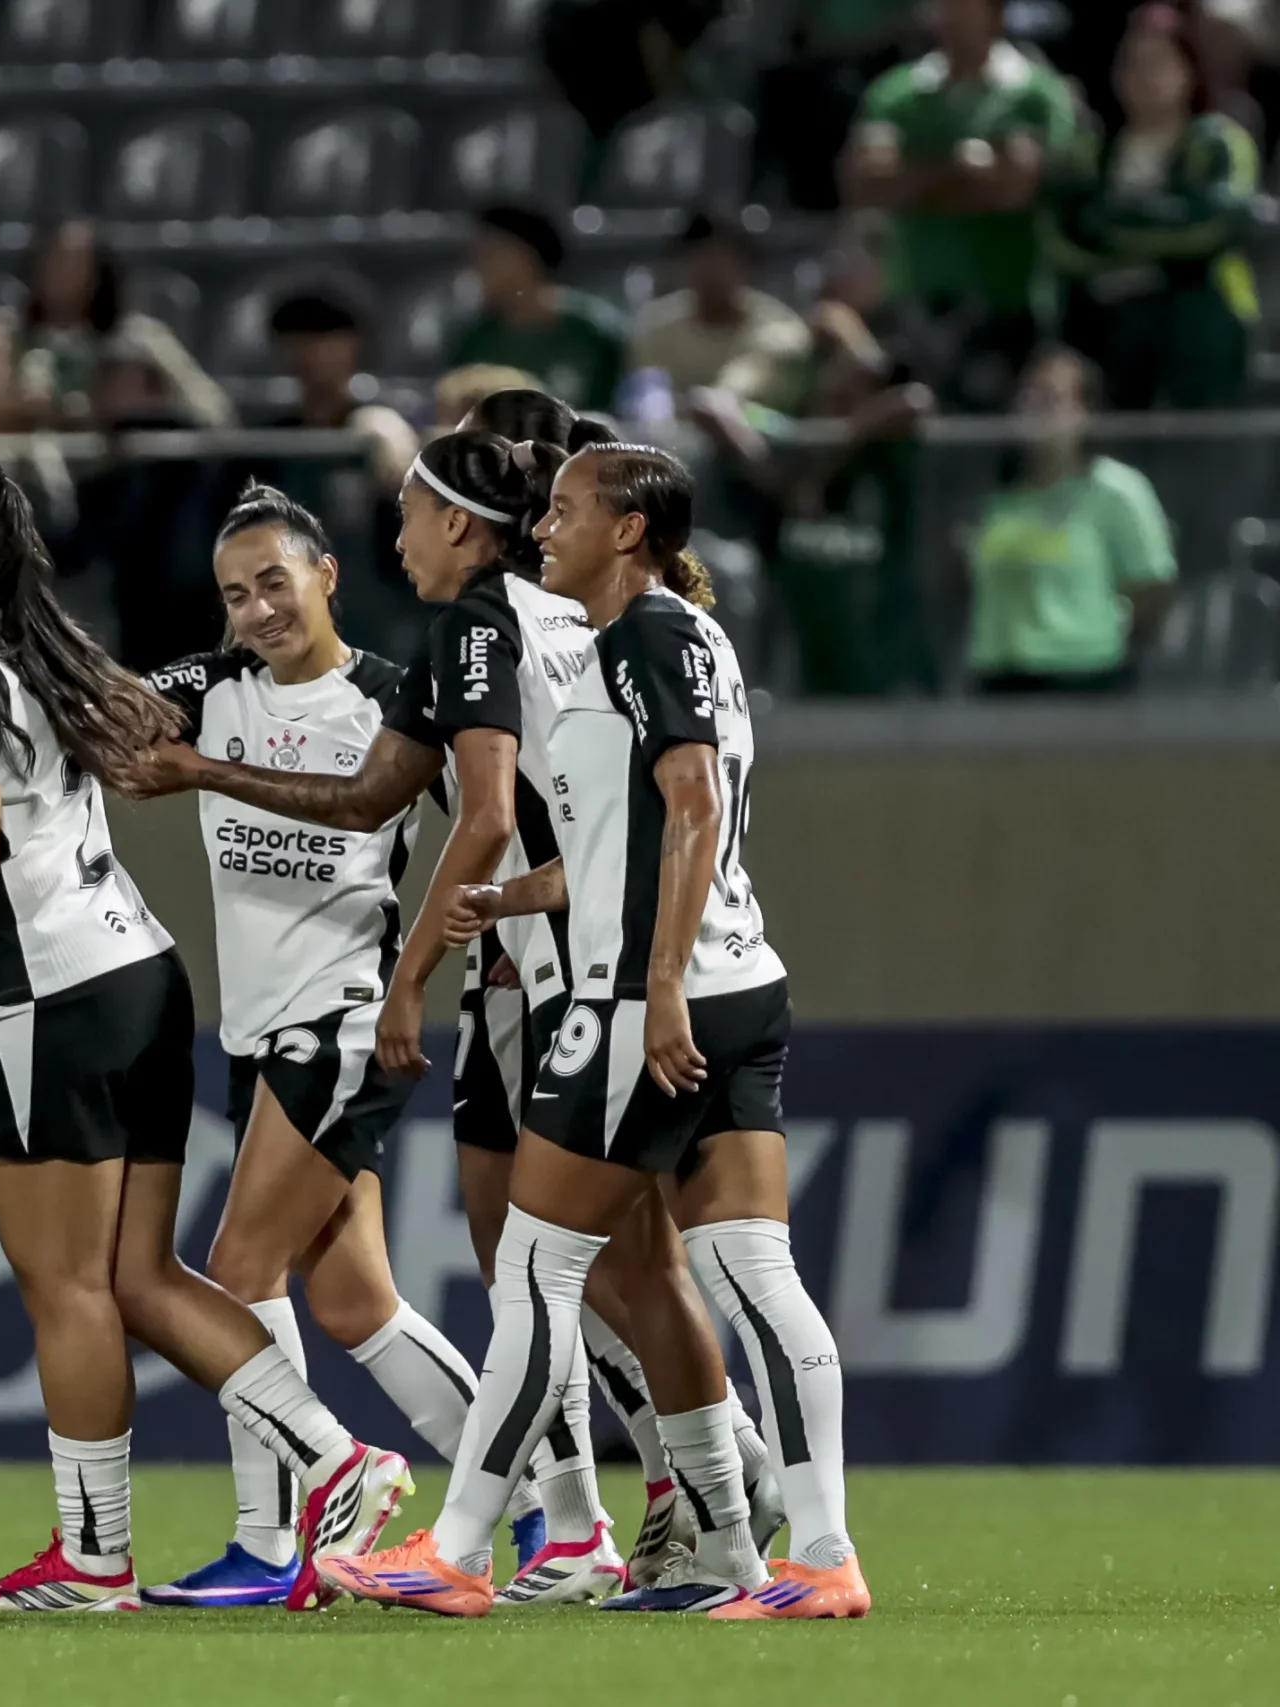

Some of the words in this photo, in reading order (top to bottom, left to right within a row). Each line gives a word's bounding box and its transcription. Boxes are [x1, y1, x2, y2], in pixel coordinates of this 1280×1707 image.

[459, 636, 468, 665] banco
[464, 626, 499, 681] bmg
[681, 649, 694, 678] banco
[634, 692, 649, 721] banco
[216, 818, 347, 856] Esportes
